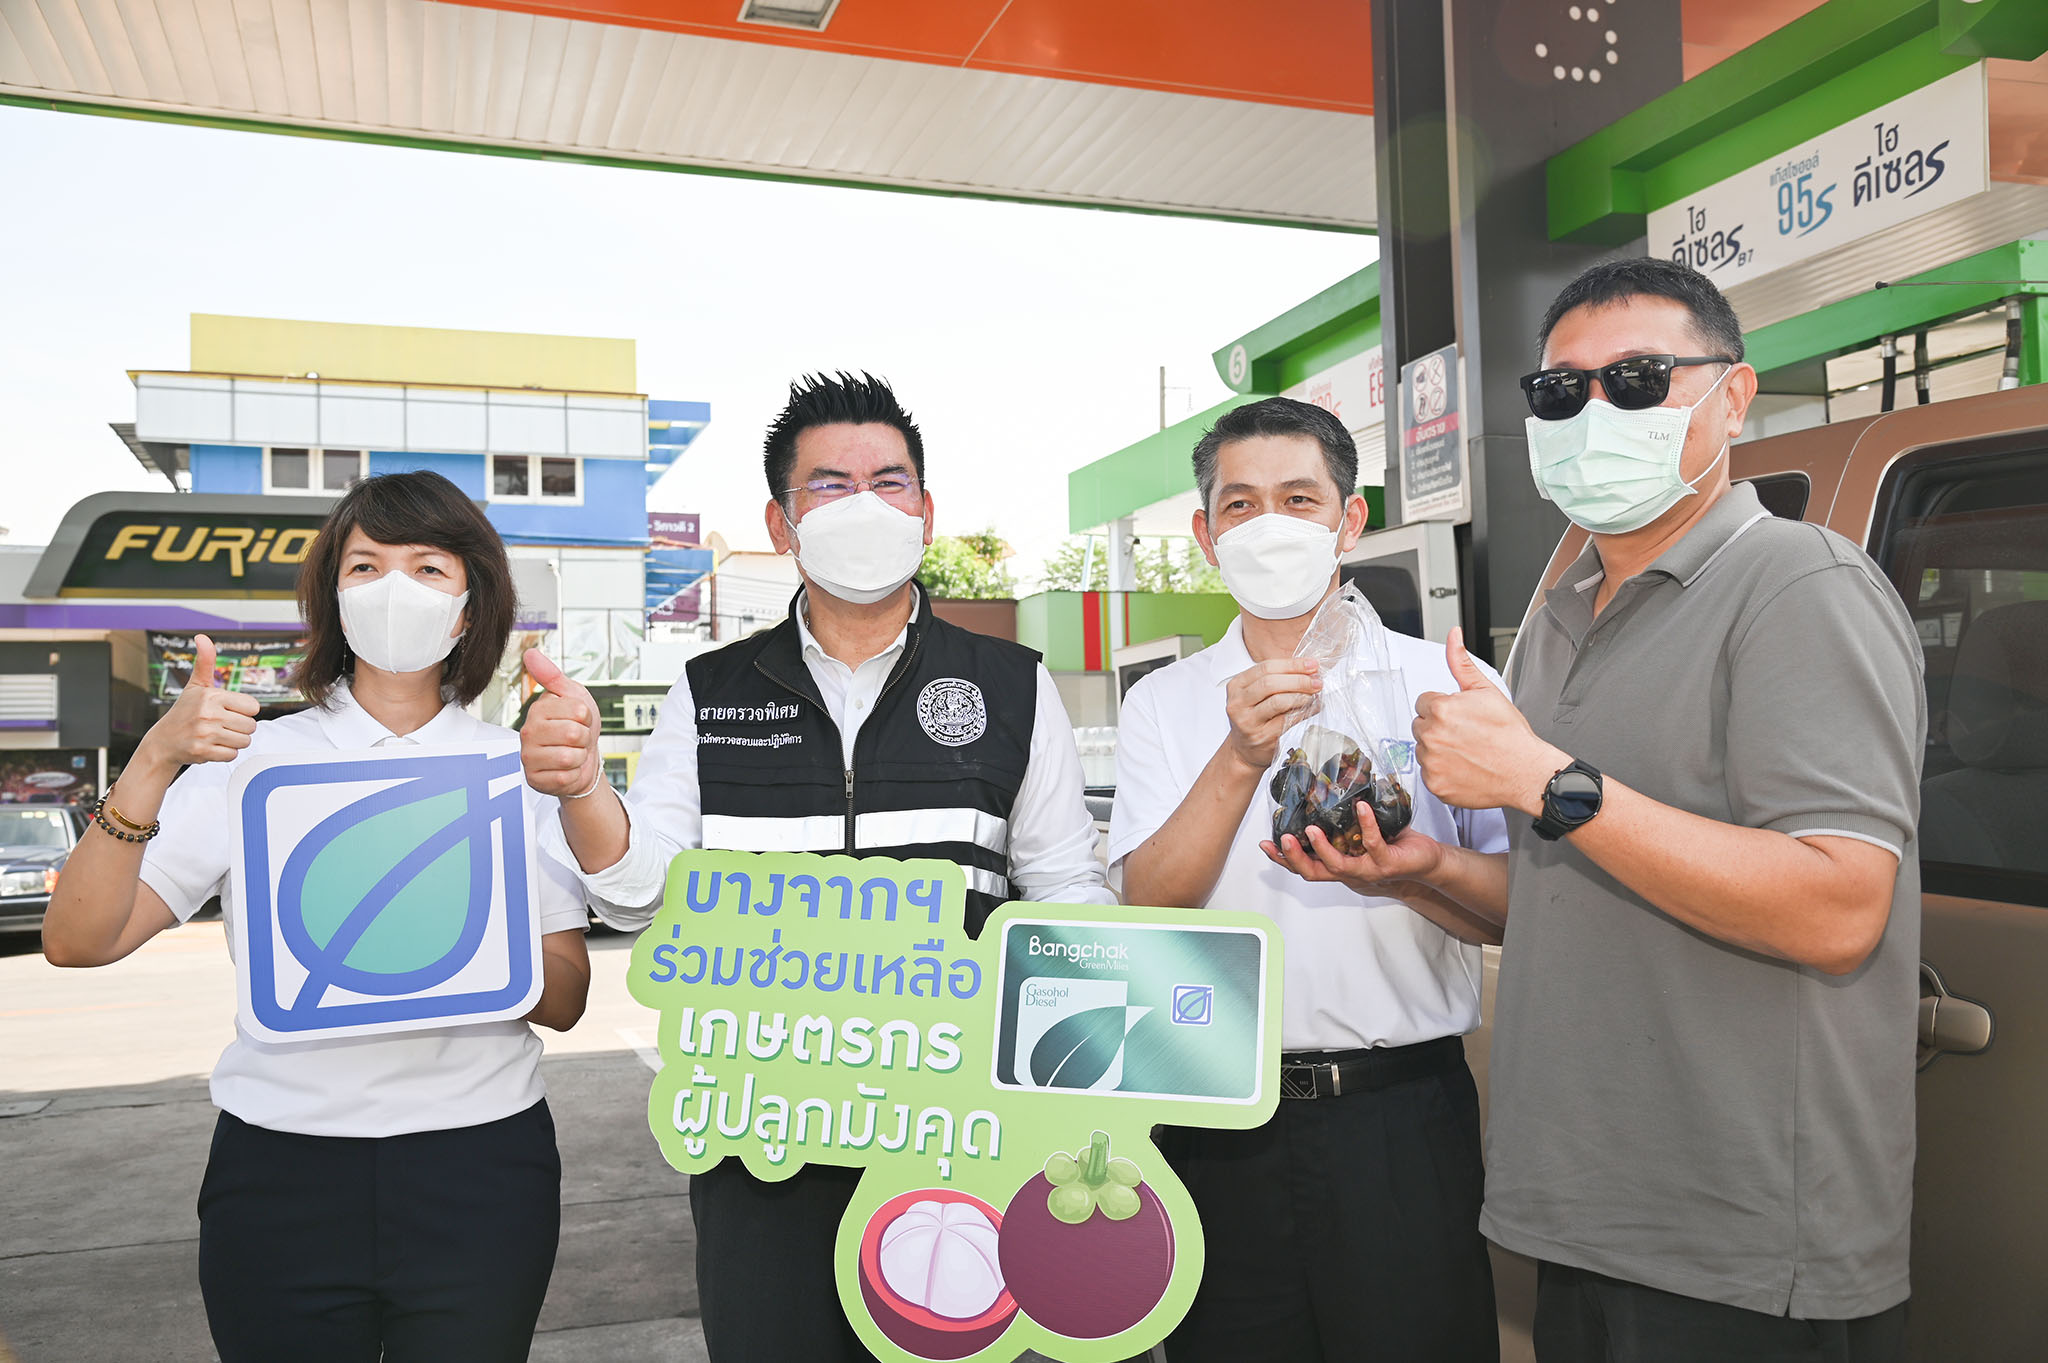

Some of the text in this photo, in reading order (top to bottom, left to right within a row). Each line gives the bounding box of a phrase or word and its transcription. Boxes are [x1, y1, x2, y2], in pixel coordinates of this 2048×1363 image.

[1873, 122, 1899, 157] ไฮ
[1687, 205, 1706, 235] ไฮ
[1738, 248, 1754, 267] B7
[1233, 351, 1242, 378] 5
[1647, 430, 1671, 441] TLM
[699, 701, 799, 721] สายตรวจพิเศษ
[696, 732, 802, 749] ำนักตรวจสอบและปฏิบัติการ
[686, 870, 943, 924] บางจากฯ
[648, 924, 982, 1000] ร่วมช่วยเหลือ
[1028, 935, 1129, 963] Bangchak
[1025, 994, 1057, 1008] Diesel
[1026, 983, 1069, 998] Gasohol
[678, 1007, 964, 1074] เกษตรกร
[671, 1063, 1002, 1181] ผู้ปลูกมังคุด
